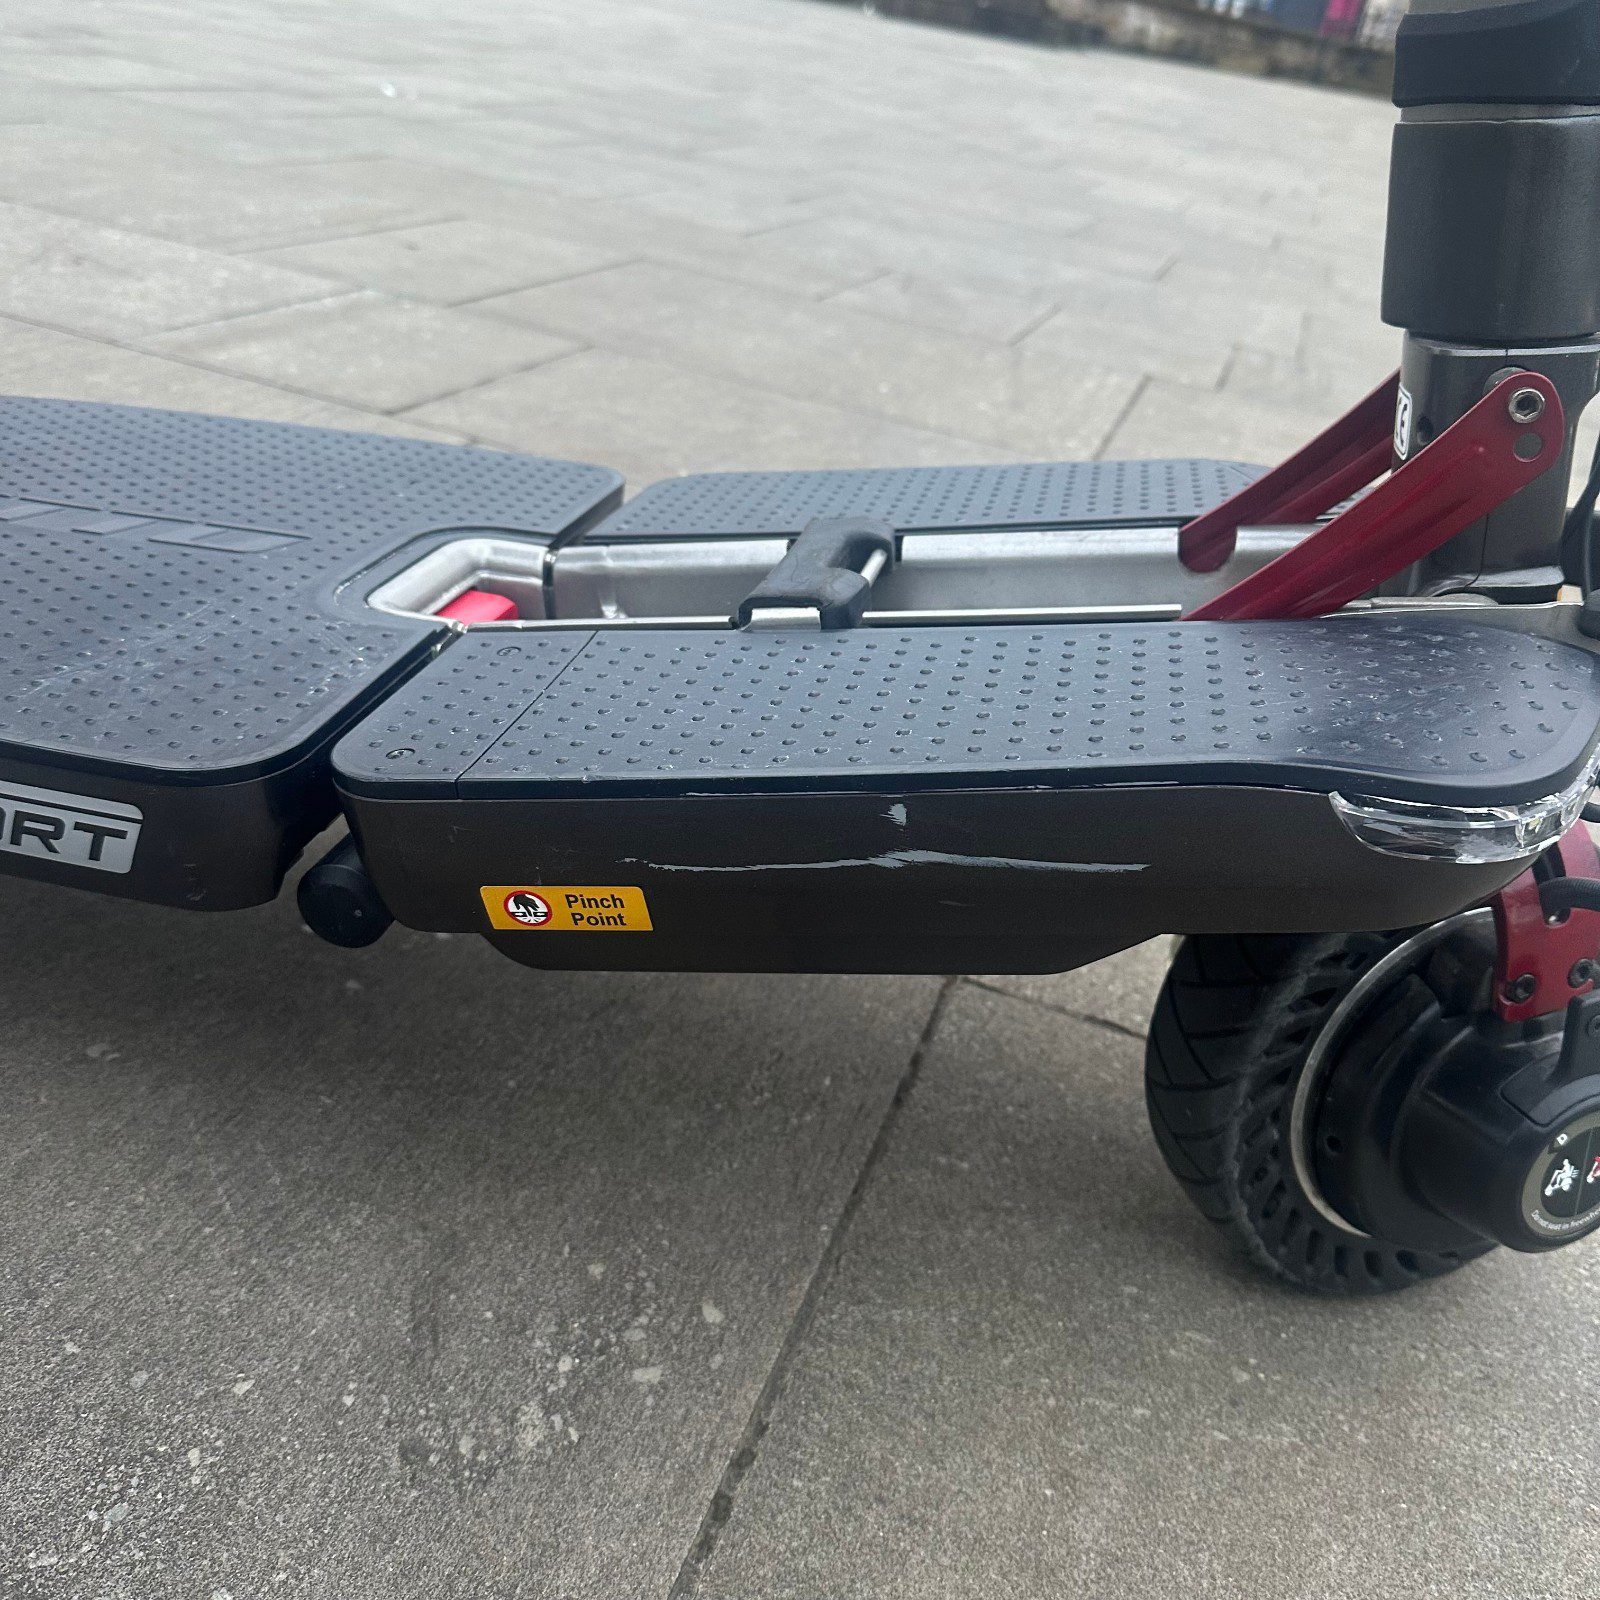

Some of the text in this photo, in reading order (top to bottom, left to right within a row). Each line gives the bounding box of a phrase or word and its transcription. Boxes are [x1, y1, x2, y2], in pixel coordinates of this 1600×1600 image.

[0, 806, 128, 861] RT
[565, 893, 625, 909] Pinch
[571, 912, 627, 926] Point
